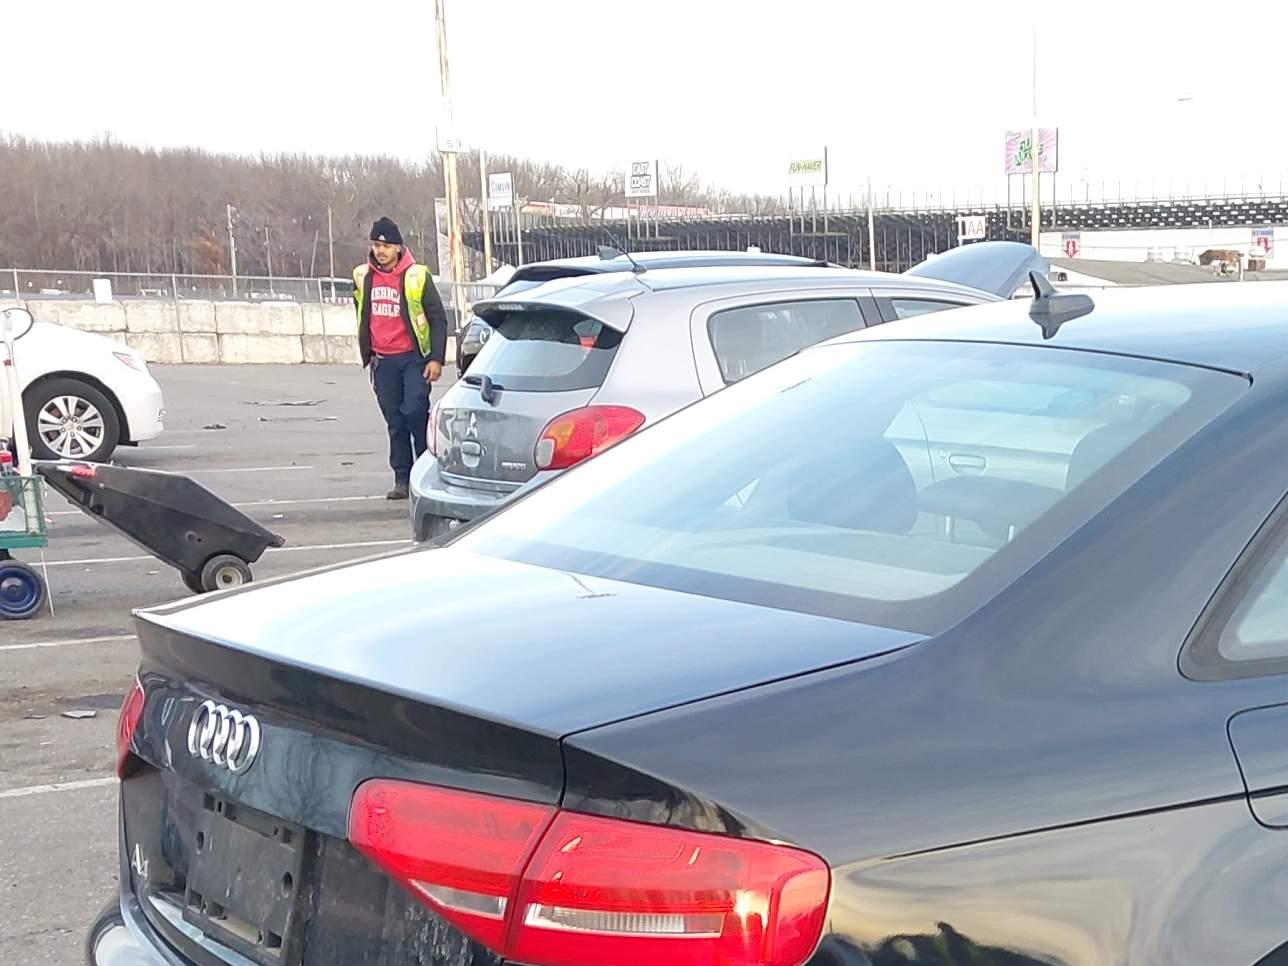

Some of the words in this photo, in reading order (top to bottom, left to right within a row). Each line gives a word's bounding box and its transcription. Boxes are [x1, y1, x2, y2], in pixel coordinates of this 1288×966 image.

[632, 161, 649, 175] EAST
[631, 175, 651, 188] COAST
[372, 302, 400, 317] EAGLE
